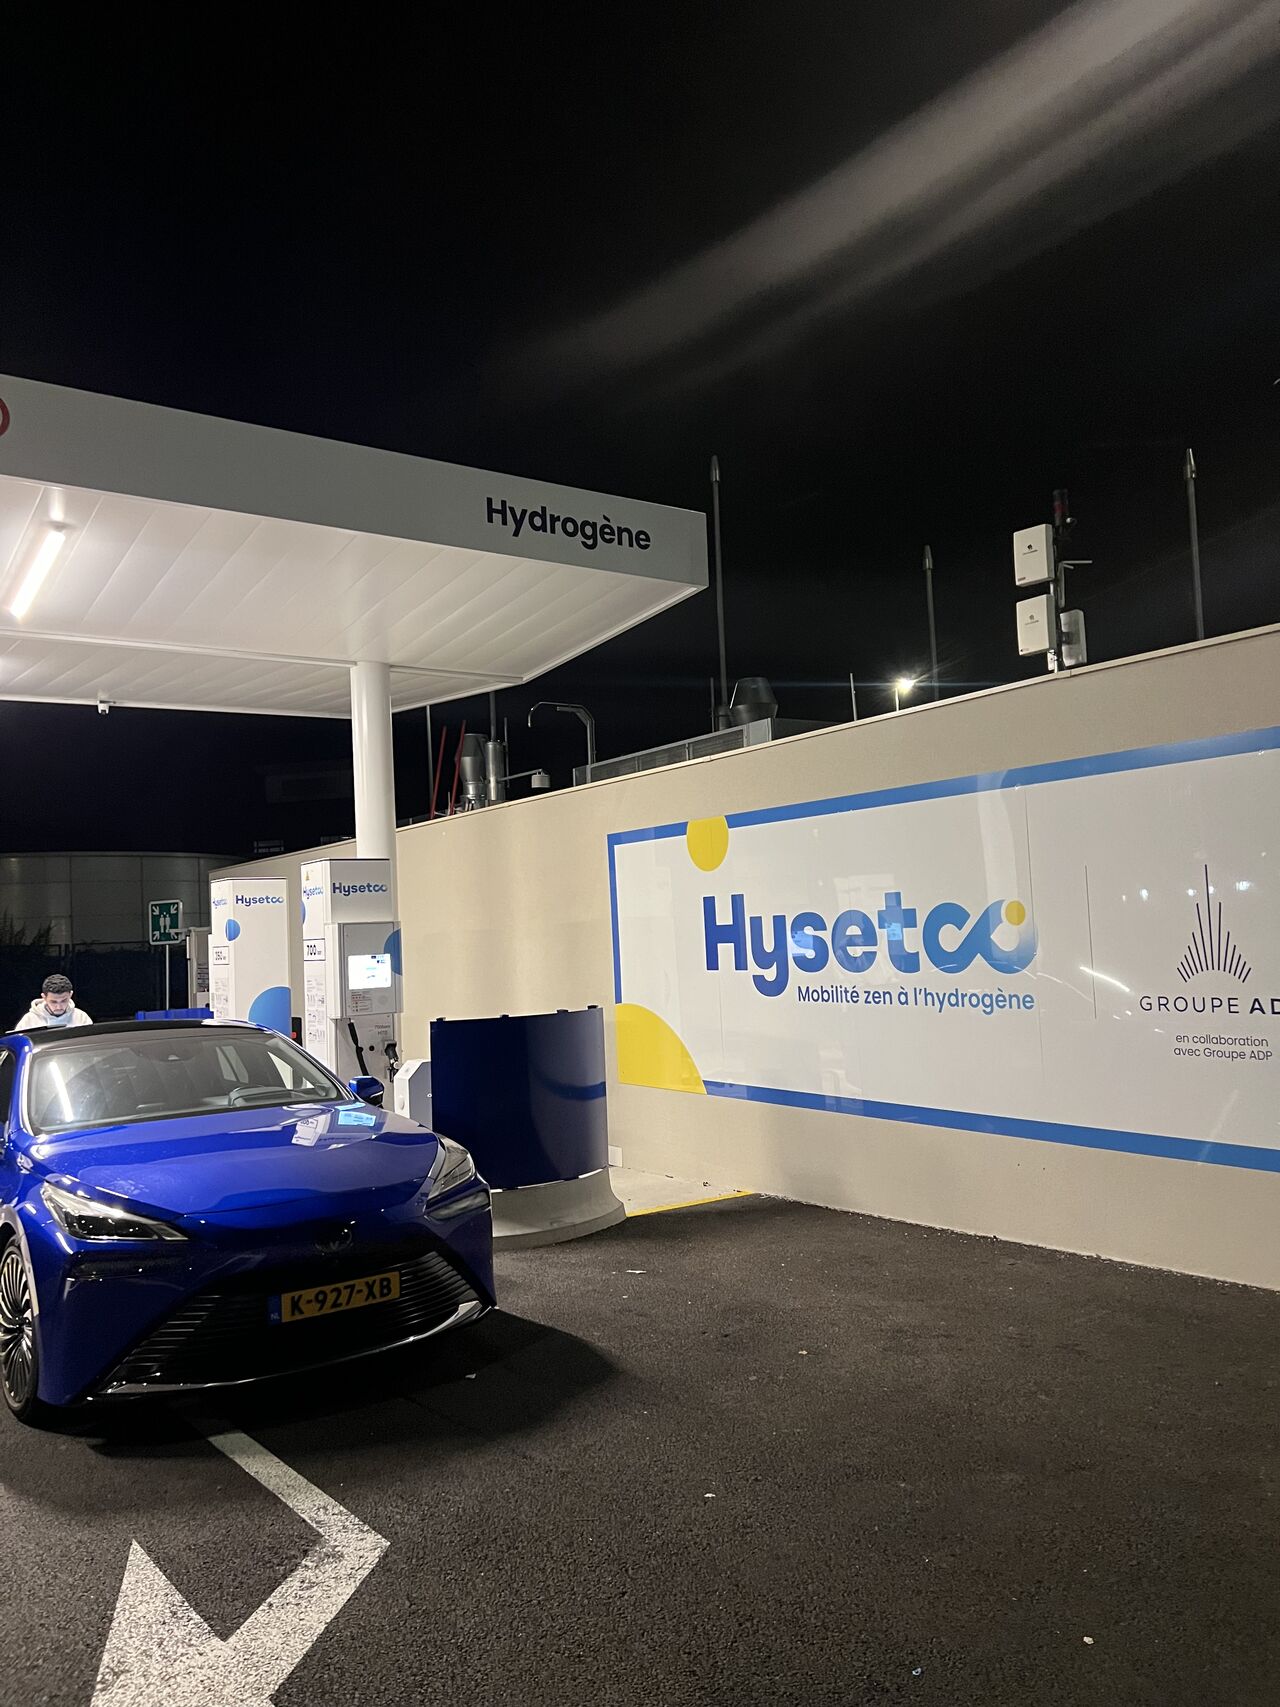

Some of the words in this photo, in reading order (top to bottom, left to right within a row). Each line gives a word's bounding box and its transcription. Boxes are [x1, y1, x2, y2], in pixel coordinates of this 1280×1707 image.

[486, 496, 651, 551] Hydrogène
[332, 881, 388, 897] Hysetco
[235, 894, 284, 907] Hysetco
[702, 891, 1039, 998] Hysetco
[797, 985, 860, 1004] Mobilité
[864, 990, 893, 1005] zen
[897, 986, 909, 1006] à
[1139, 995, 1240, 1014] GROUPE
[1175, 1034, 1190, 1044] en
[1192, 1034, 1269, 1047] collaboration
[1173, 1047, 1201, 1057] avec
[1203, 1047, 1247, 1061] Groupe
[1249, 1050, 1273, 1061] ADP
[290, 1277, 392, 1317] K-927-XB
